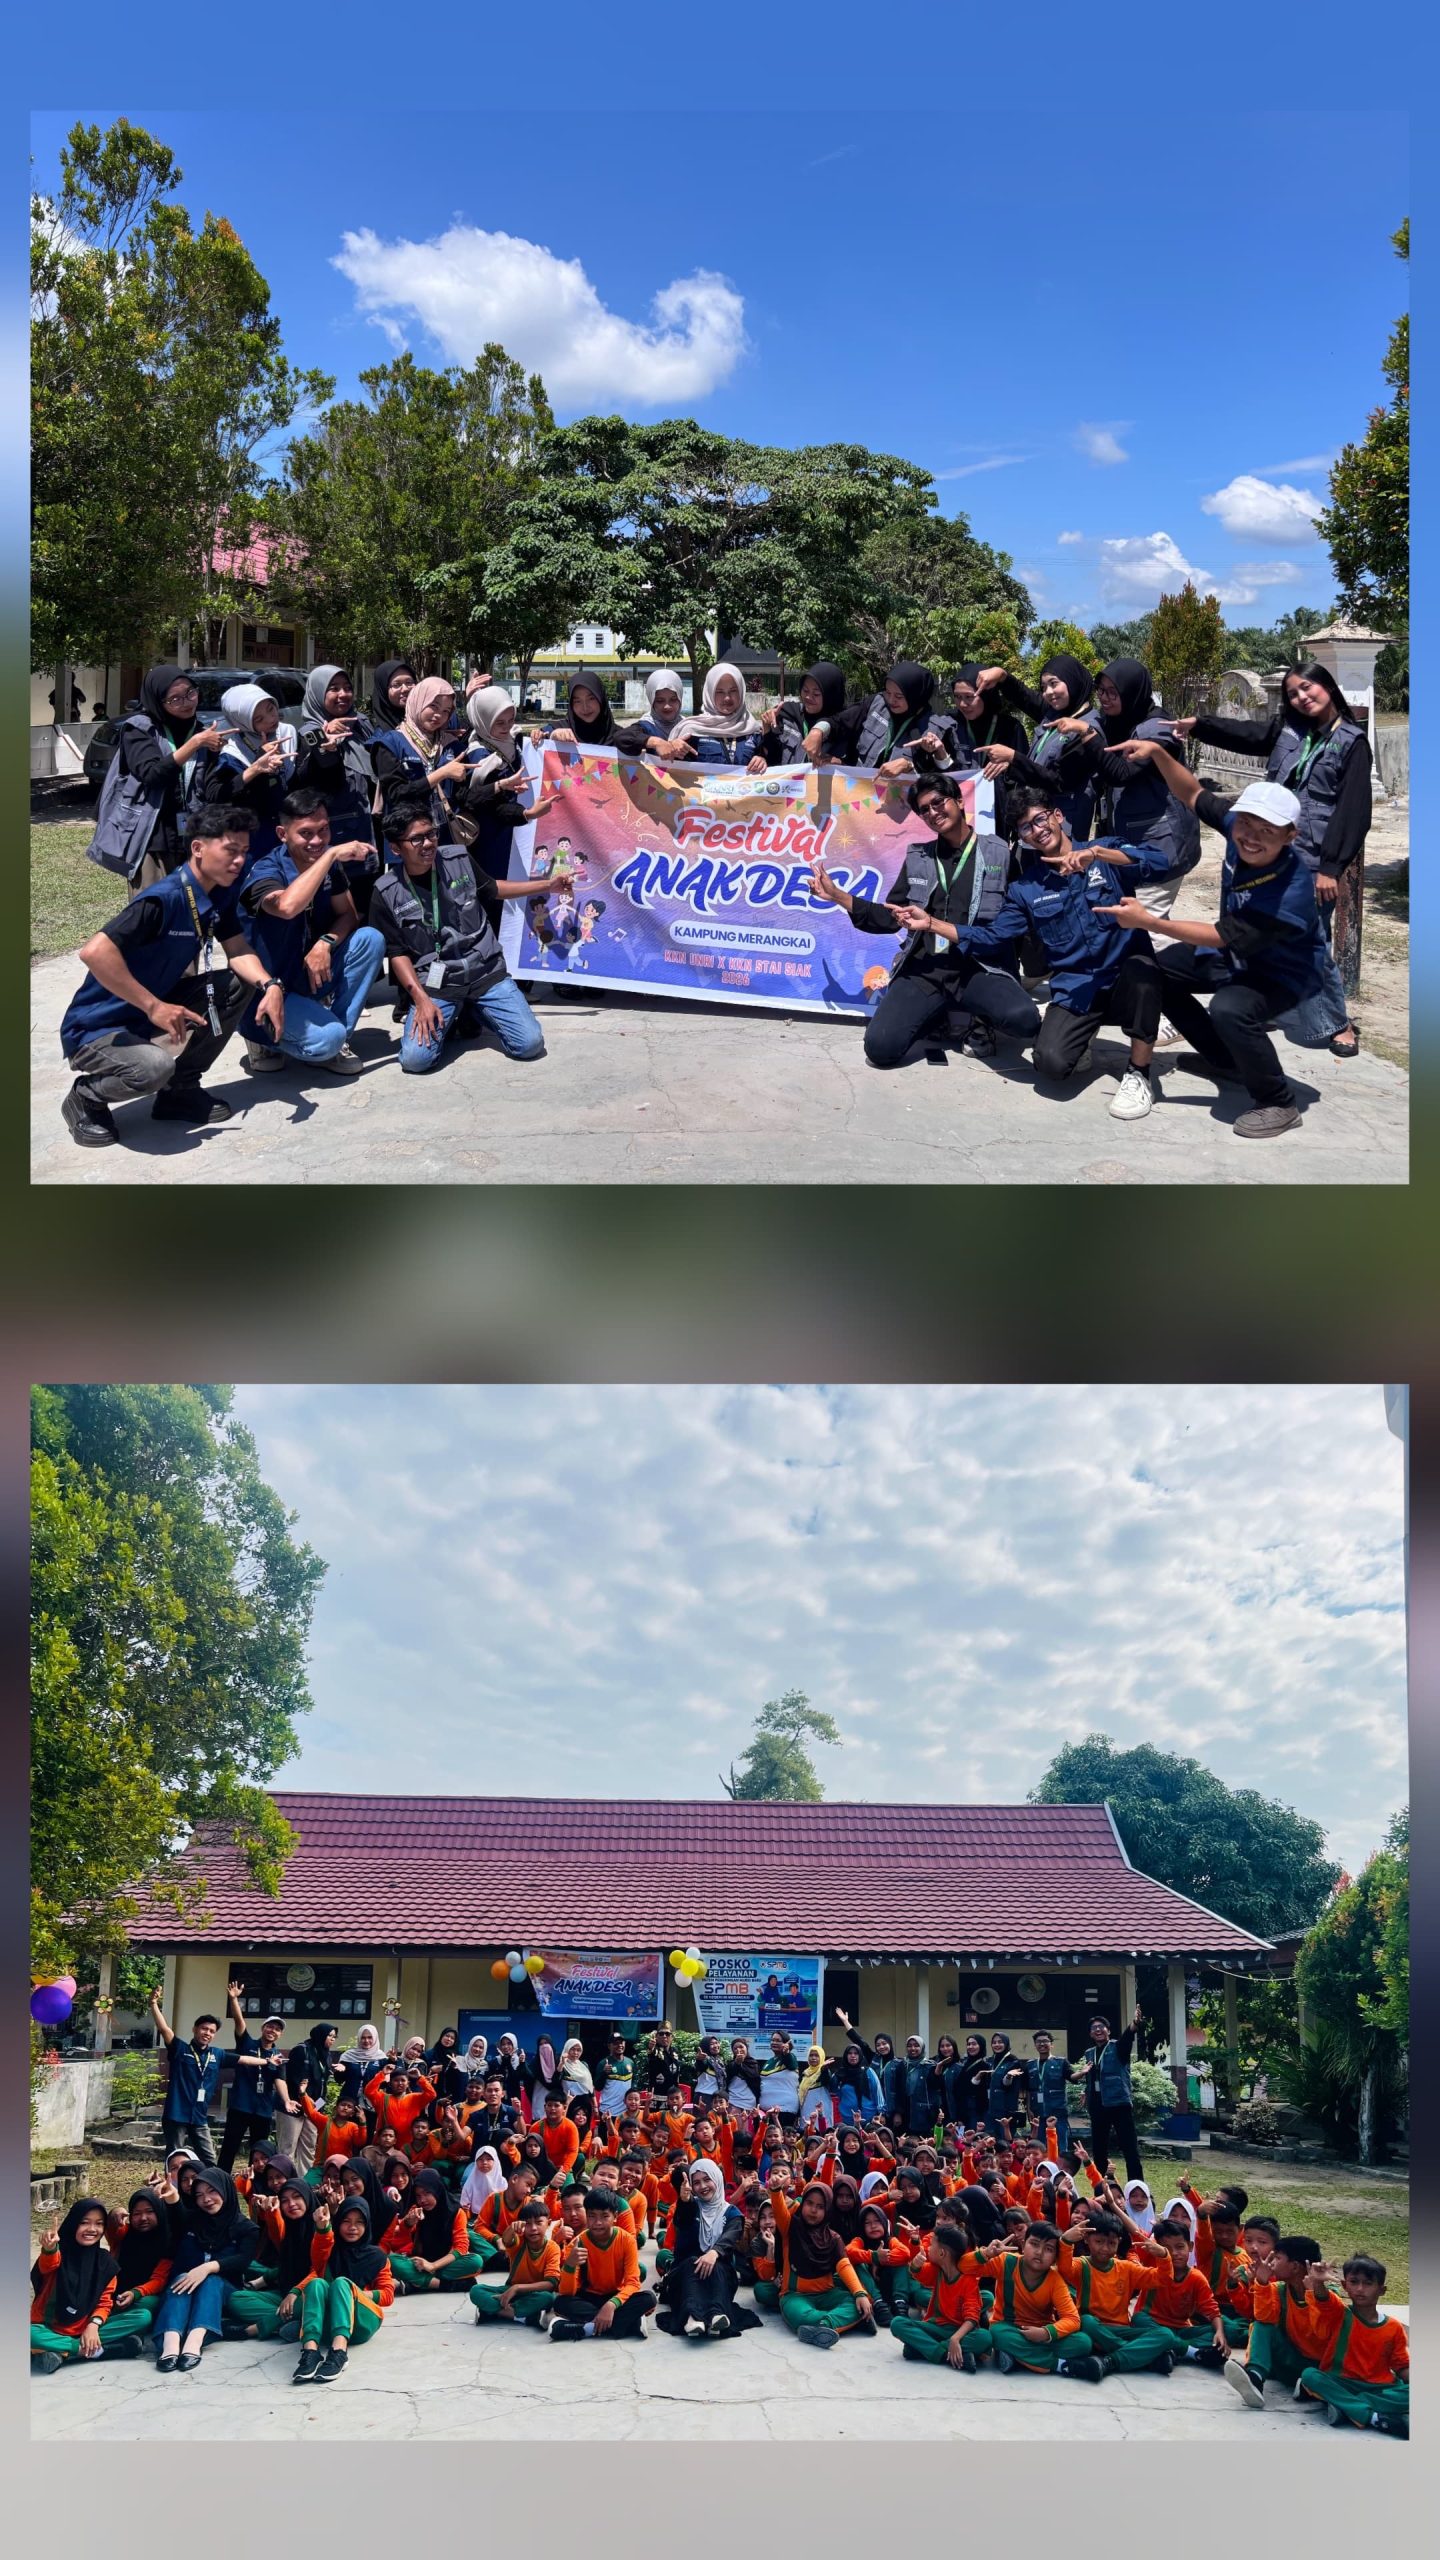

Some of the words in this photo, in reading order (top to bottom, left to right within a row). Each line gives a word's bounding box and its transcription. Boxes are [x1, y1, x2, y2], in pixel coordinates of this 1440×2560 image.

[675, 806, 837, 863] Festival
[612, 849, 745, 914] ANAK
[674, 926, 737, 942] KAMPUNG
[738, 932, 811, 949] MERANGKAI
[664, 949, 687, 964] KKN
[690, 952, 715, 968] UNRI
[718, 956, 726, 969] X
[729, 957, 752, 972] KKN
[755, 959, 782, 975] STAI
[785, 962, 812, 978] SIAK
[722, 971, 750, 986] 2026
[571, 1964, 619, 1979] Festival
[709, 1959, 751, 1969] POSKO
[708, 1969, 755, 1978] PELAYANAN
[554, 1979, 592, 1995] ANAK
[592, 1979, 633, 1997] DESA
[704, 1982, 749, 1994] SPMB
